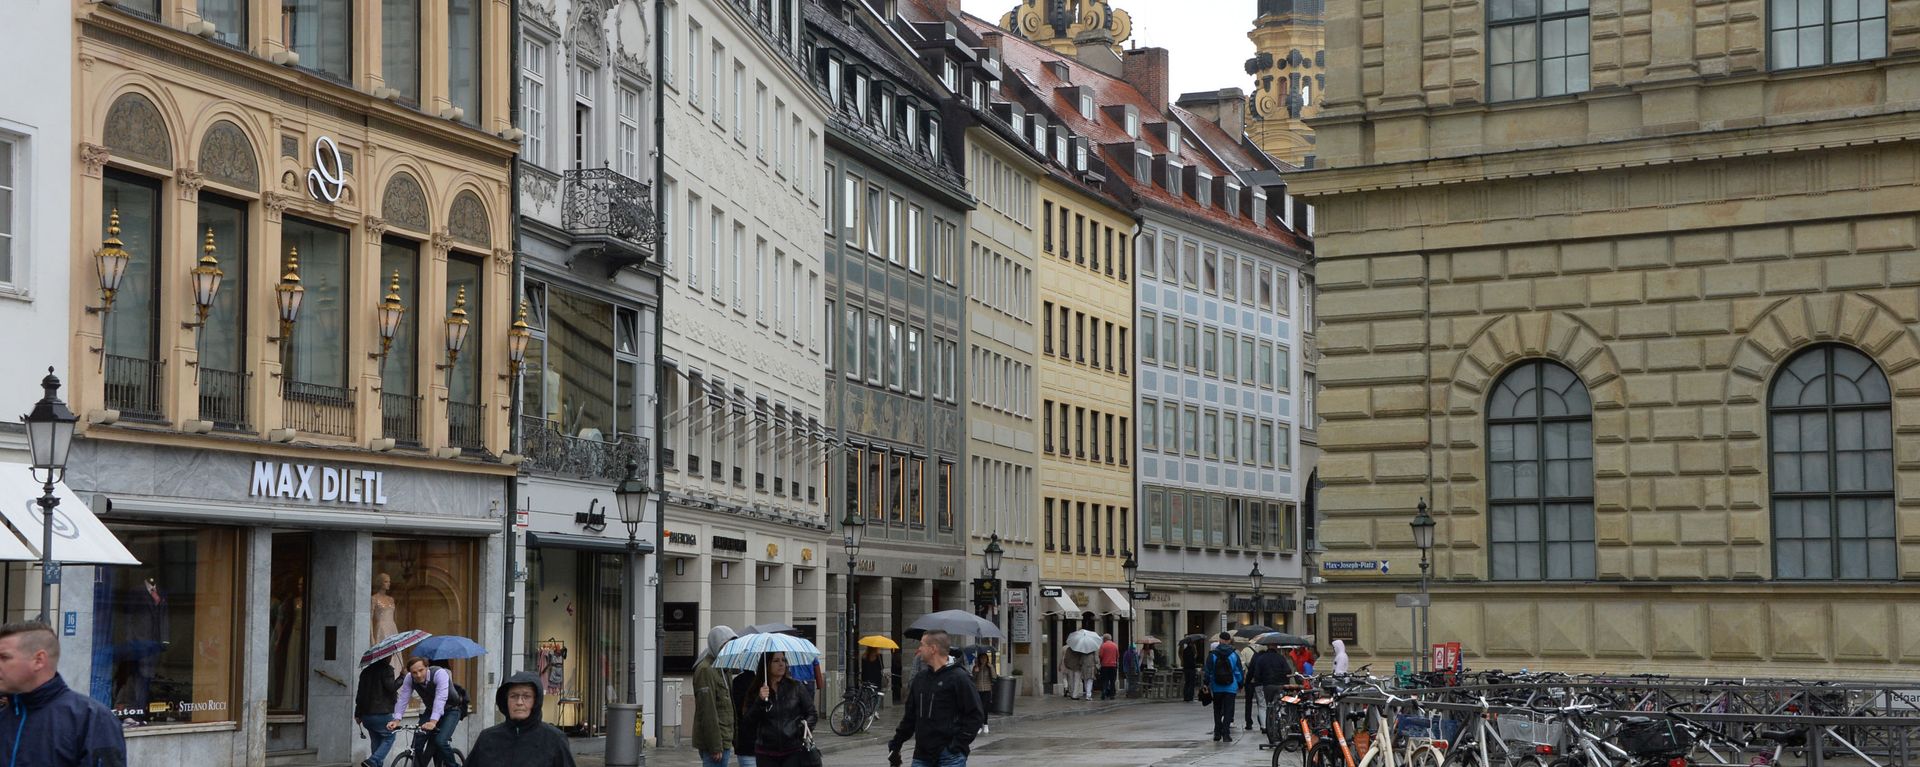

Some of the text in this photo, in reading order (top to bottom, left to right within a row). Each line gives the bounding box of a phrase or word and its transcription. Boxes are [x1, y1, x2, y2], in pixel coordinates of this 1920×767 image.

[251, 460, 387, 504] MAX DIETL
[67, 614, 75, 625] 16
[179, 700, 207, 713] STEFANO
[208, 699, 227, 711] RICCI
